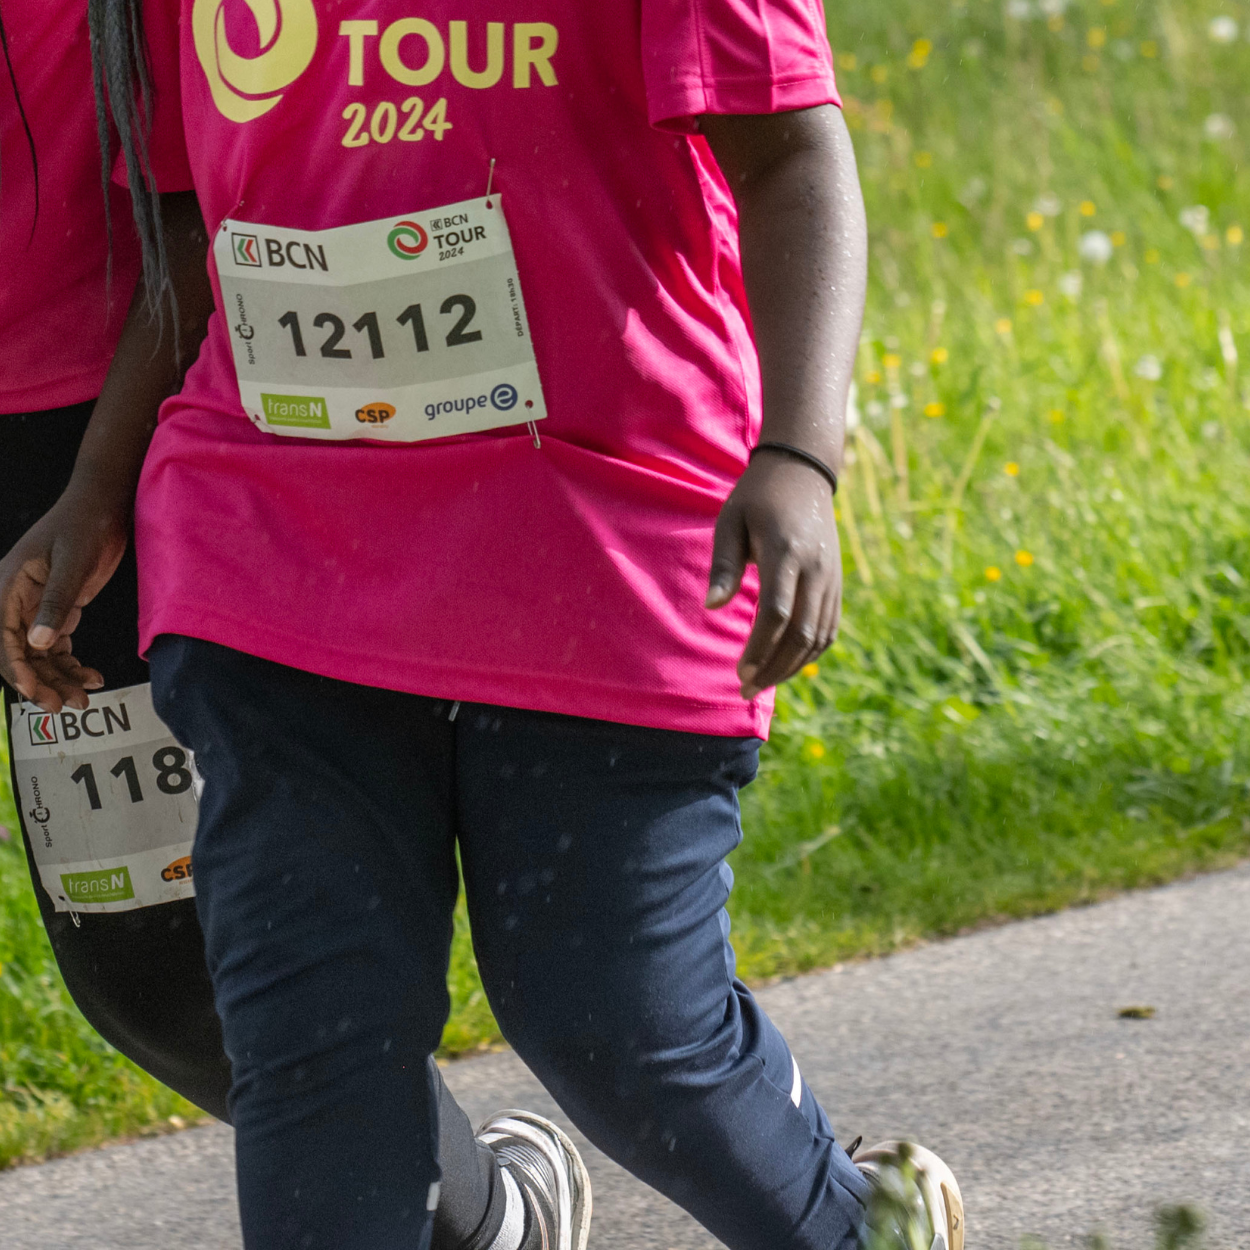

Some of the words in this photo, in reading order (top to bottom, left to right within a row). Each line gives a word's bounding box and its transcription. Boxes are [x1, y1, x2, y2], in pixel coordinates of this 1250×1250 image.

[339, 17, 559, 89] TOUR
[341, 96, 453, 148] 2024
[444, 213, 469, 228] BCN
[433, 225, 486, 250] TOUR
[265, 238, 329, 272] BCN
[438, 246, 464, 261] 2024
[278, 294, 483, 360] 12112
[268, 399, 322, 418] transN
[355, 409, 390, 423] CSP
[424, 394, 488, 420] groupe
[60, 703, 131, 741] BCN
[69, 872, 124, 893] transN
